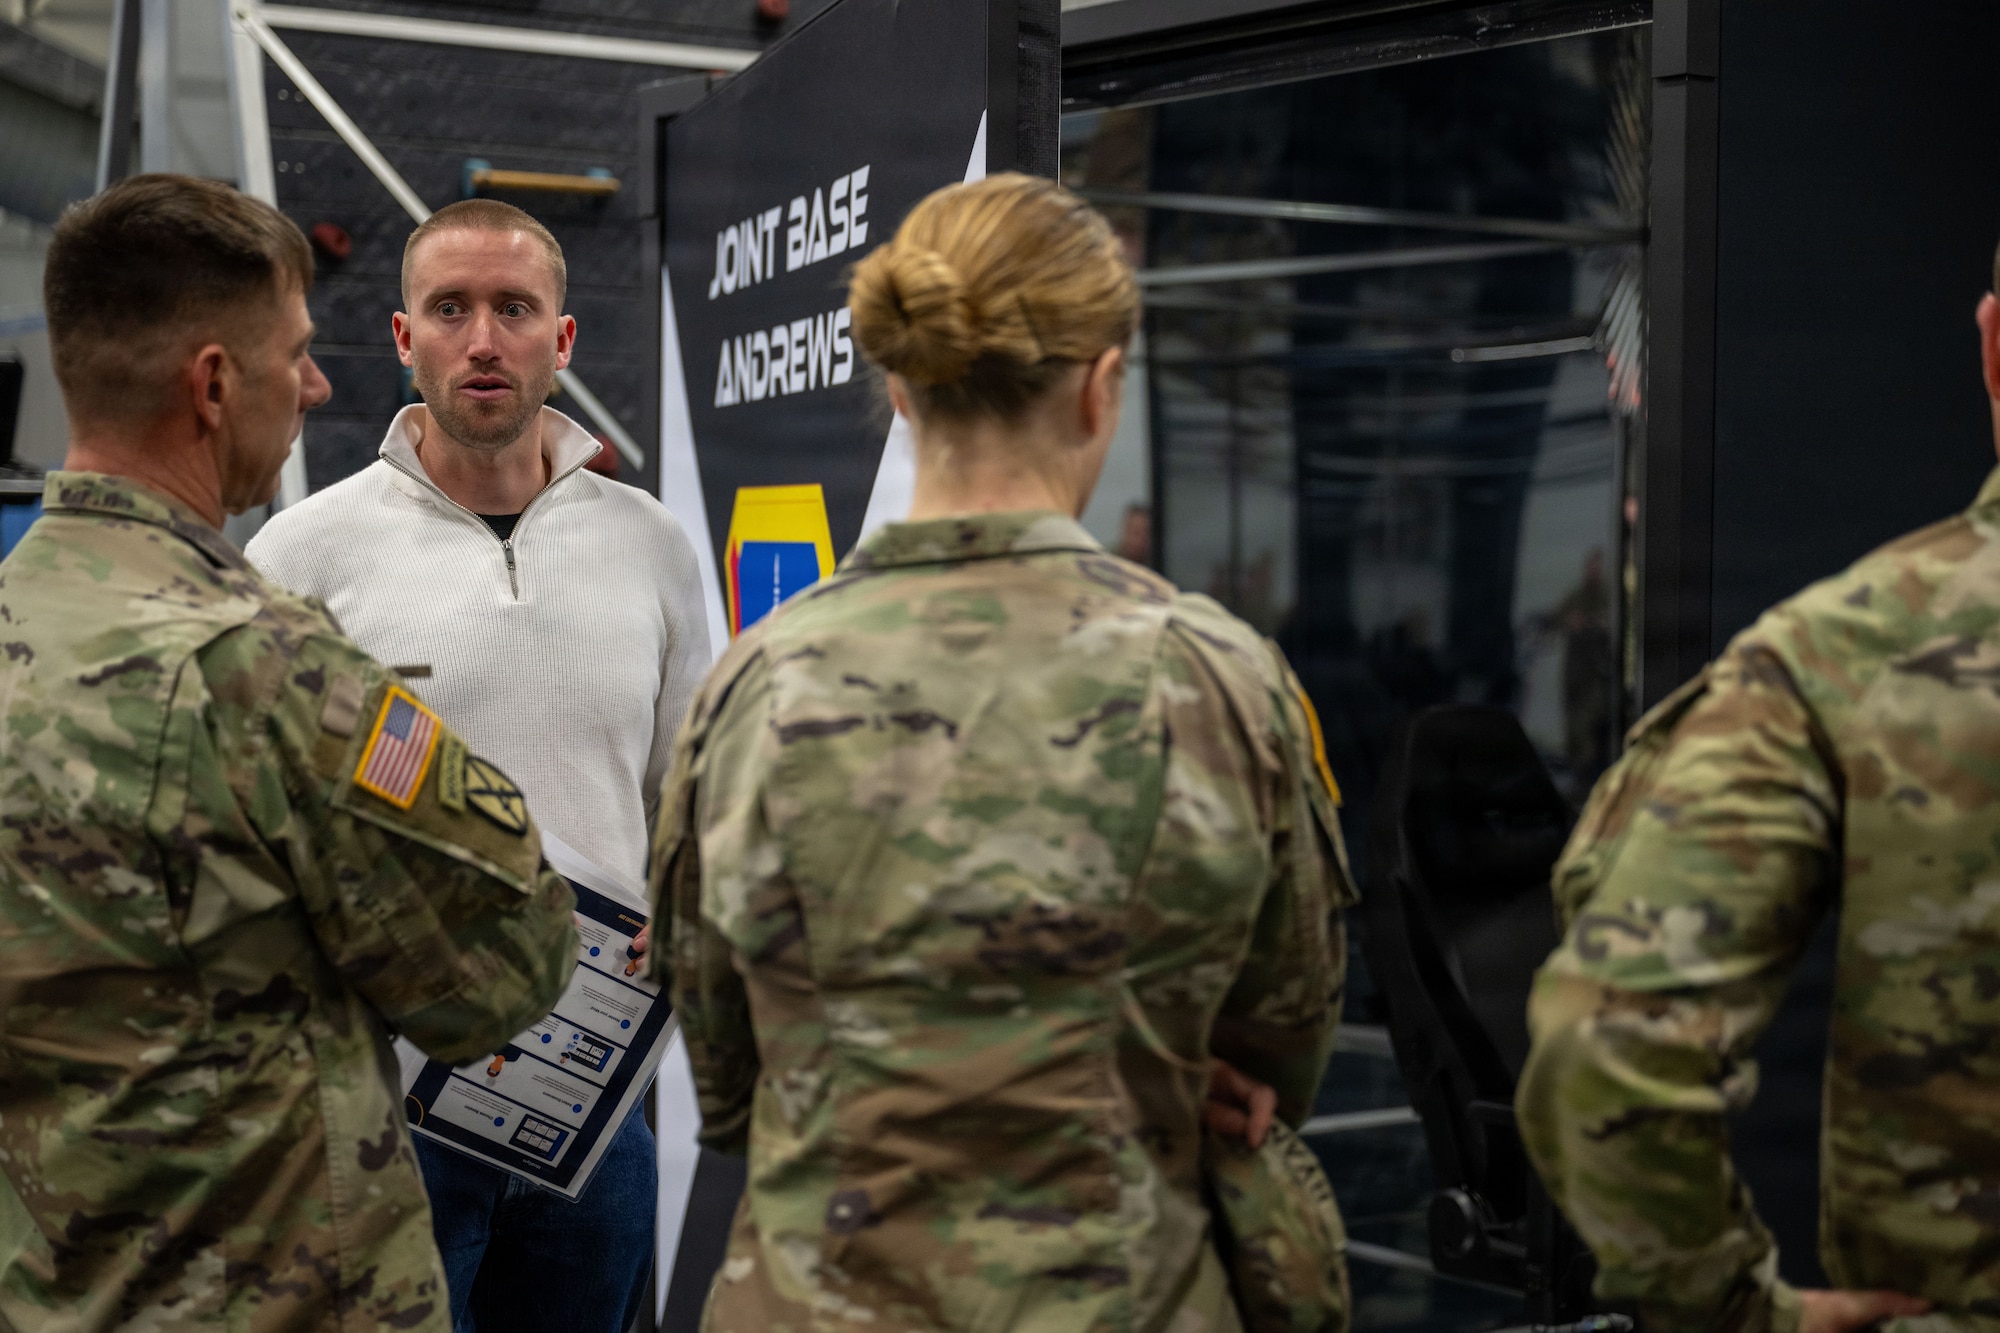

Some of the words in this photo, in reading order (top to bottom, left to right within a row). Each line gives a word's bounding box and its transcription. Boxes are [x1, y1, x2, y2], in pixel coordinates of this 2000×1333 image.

[708, 205, 782, 300] JOINT
[786, 164, 870, 273] BASE
[714, 305, 854, 408] ANDREWS
